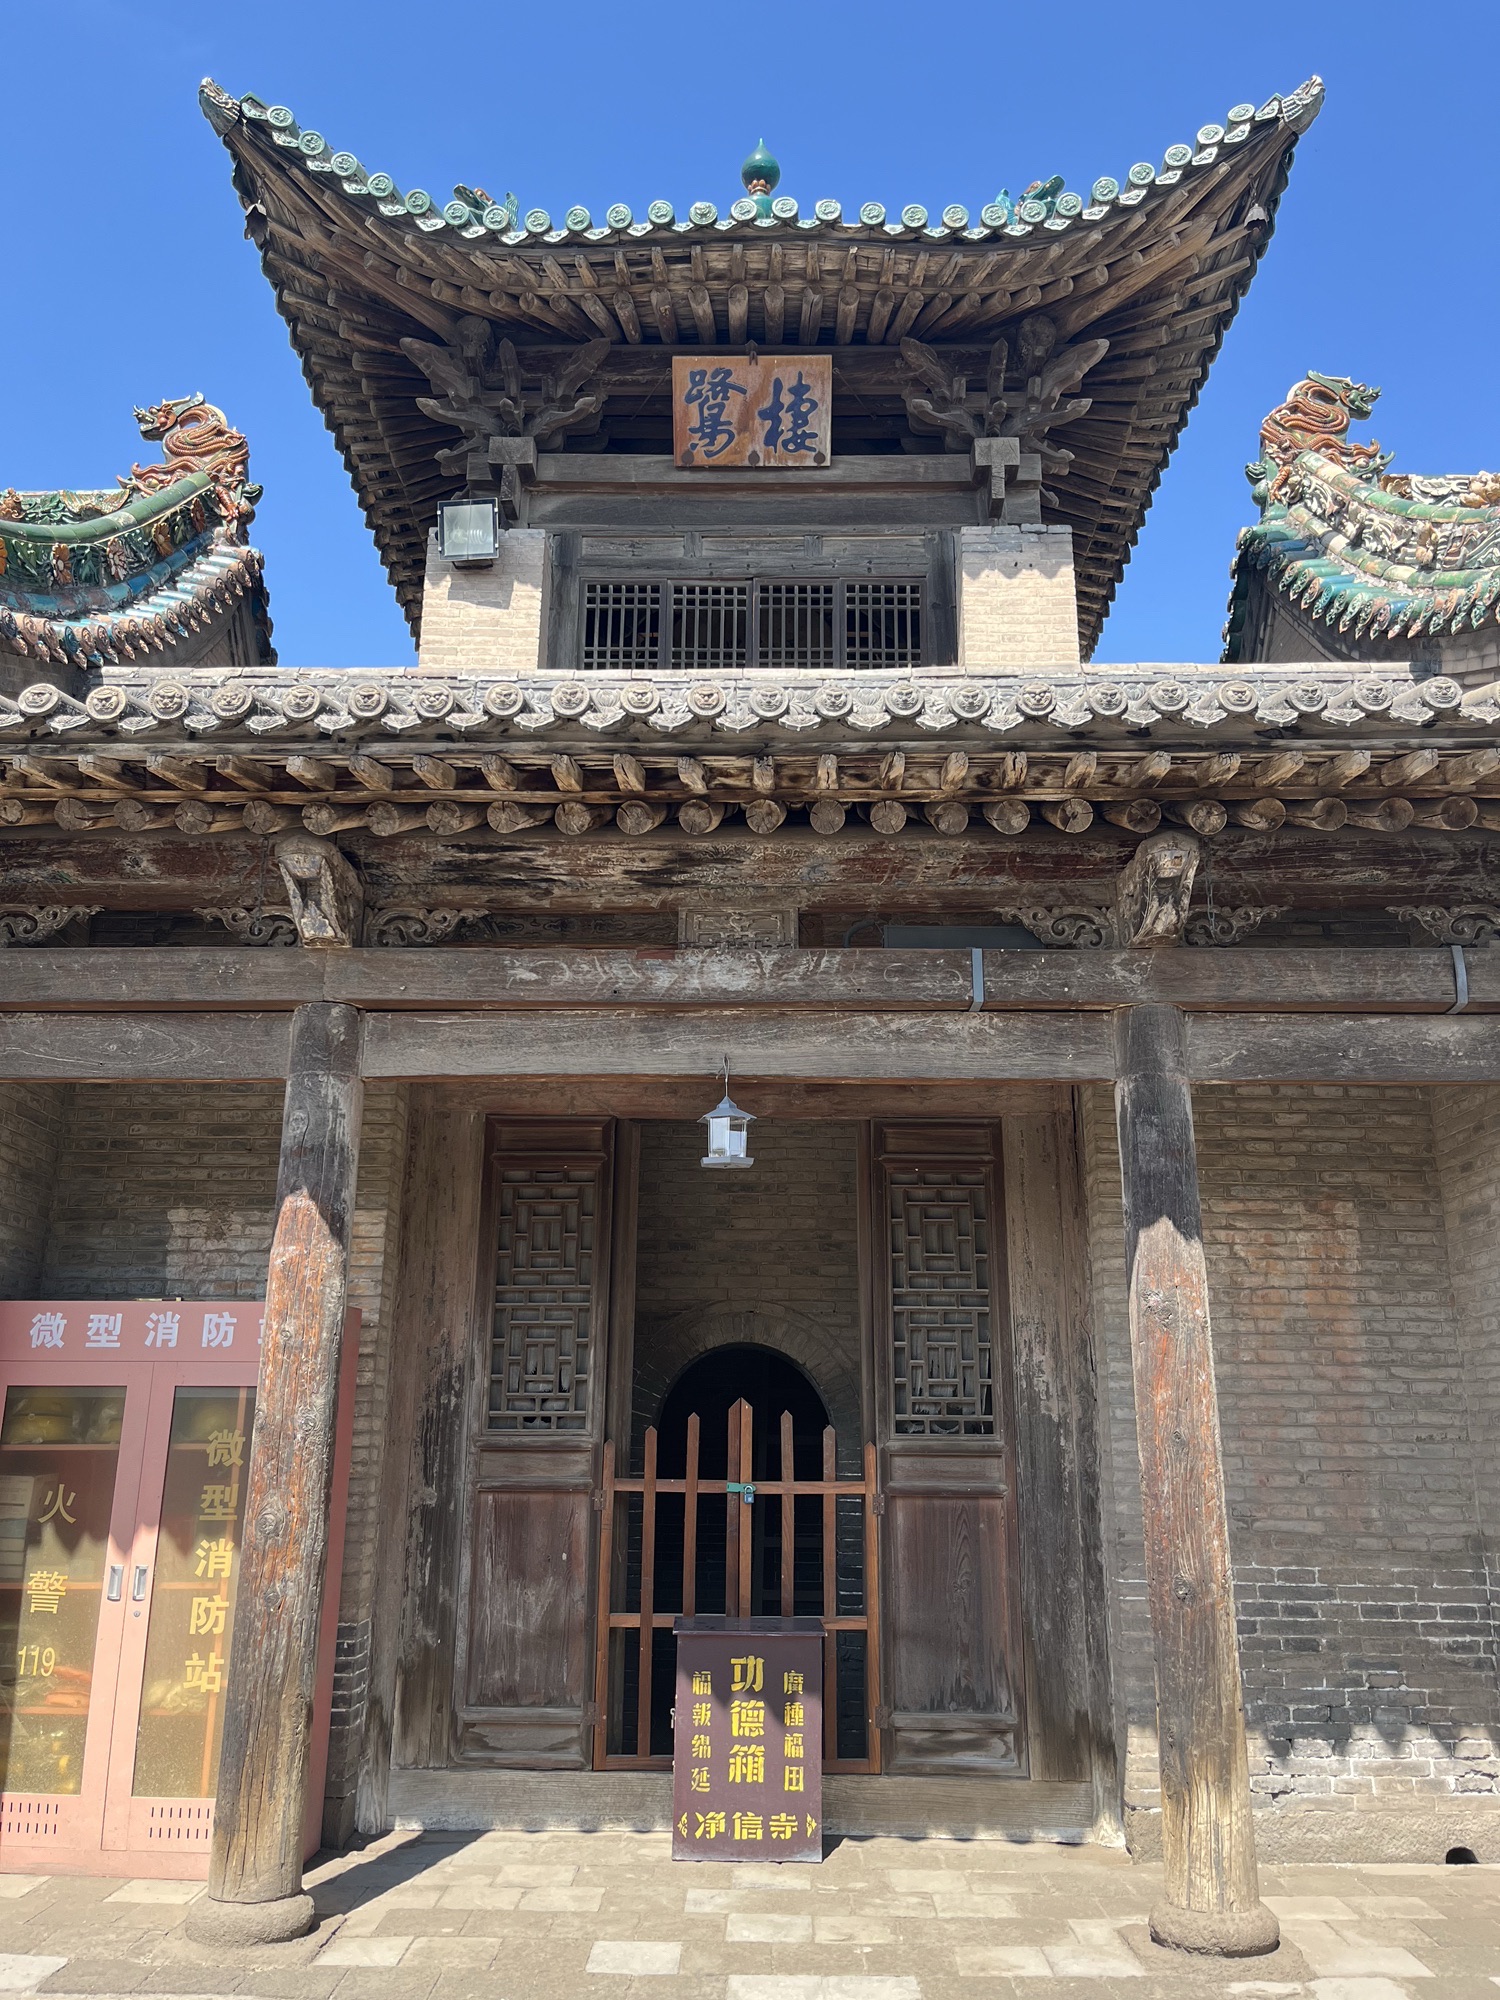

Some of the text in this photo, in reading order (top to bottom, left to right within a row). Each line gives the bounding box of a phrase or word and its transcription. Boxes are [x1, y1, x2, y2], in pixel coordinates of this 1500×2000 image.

[30, 1311, 264, 1348] 微型消防
[27, 1484, 77, 1613] 火警
[183, 1429, 246, 1692] 微型消防站
[18, 1646, 56, 1677] 119
[728, 1655, 766, 1783] 功德箱
[783, 1670, 805, 1793] 廣種福田
